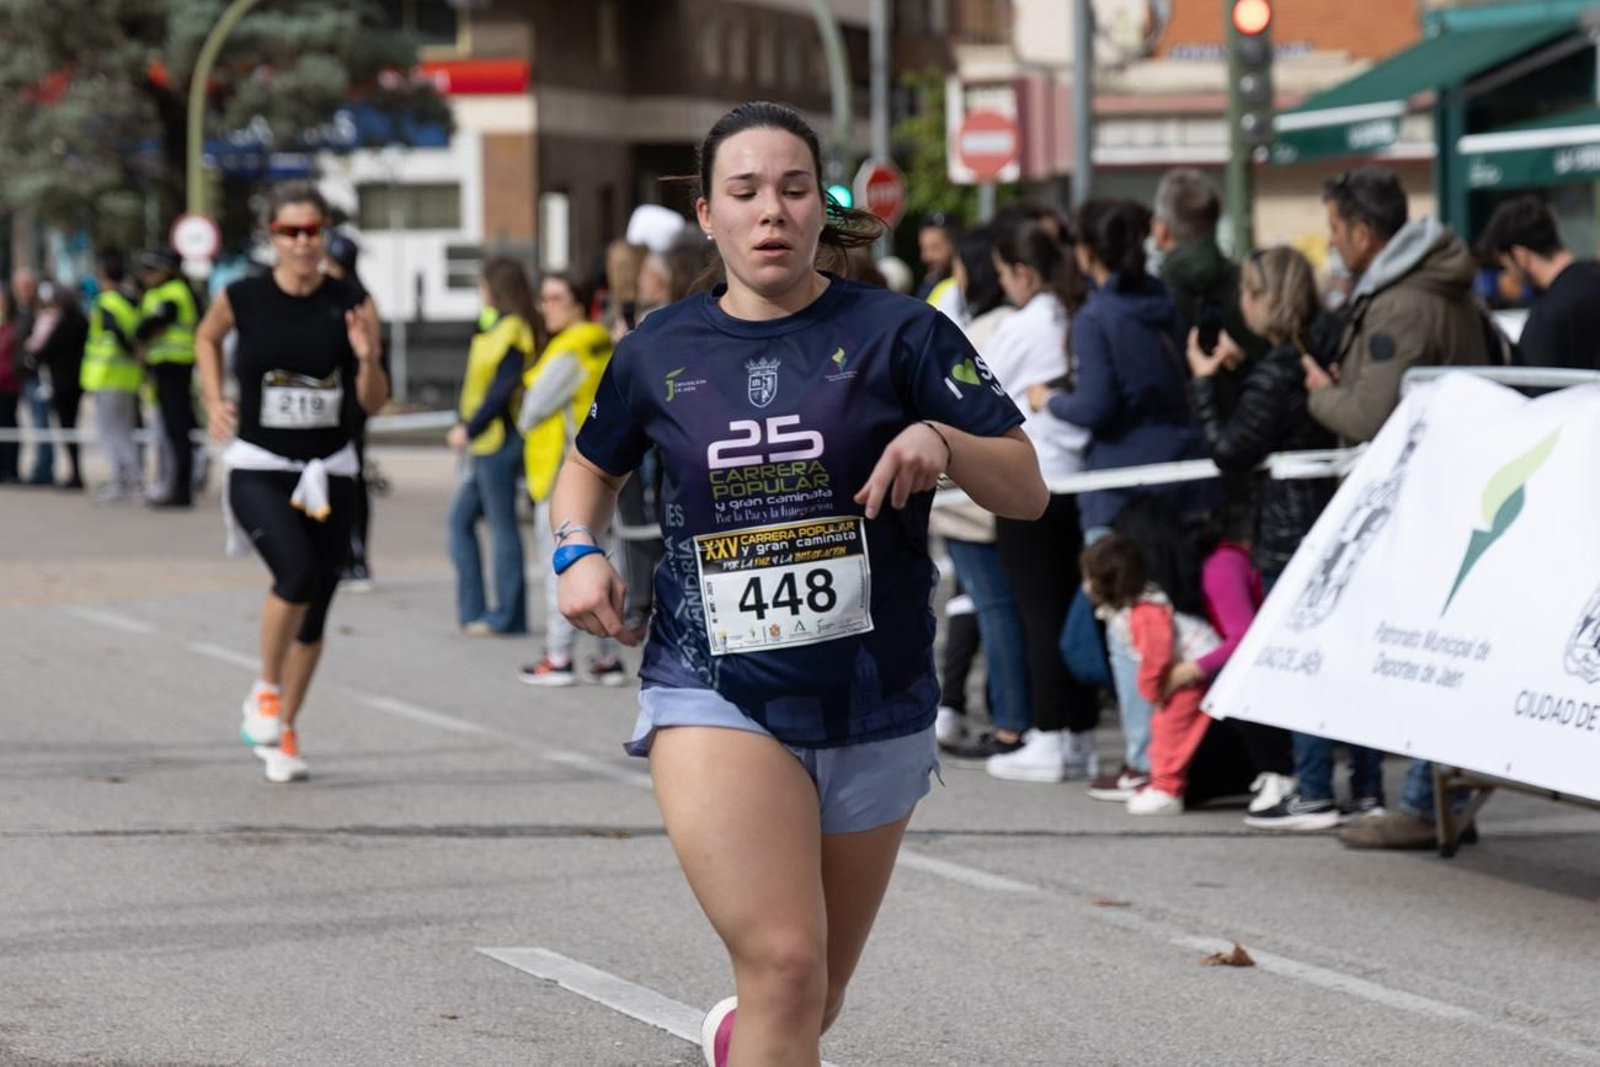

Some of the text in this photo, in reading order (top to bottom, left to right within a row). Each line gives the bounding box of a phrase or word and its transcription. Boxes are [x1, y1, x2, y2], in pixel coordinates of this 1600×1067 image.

[708, 415, 824, 469] 25
[709, 460, 826, 484] CARRERA
[713, 474, 830, 499] POPULAR
[729, 498, 762, 510] gran
[767, 489, 833, 504] caminata
[703, 521, 856, 560] XXV CARRERA POPULAR
[757, 541, 789, 555] gran
[796, 531, 856, 548] caminata
[739, 568, 837, 620] 448
[1515, 689, 1577, 725] CIUDAD
